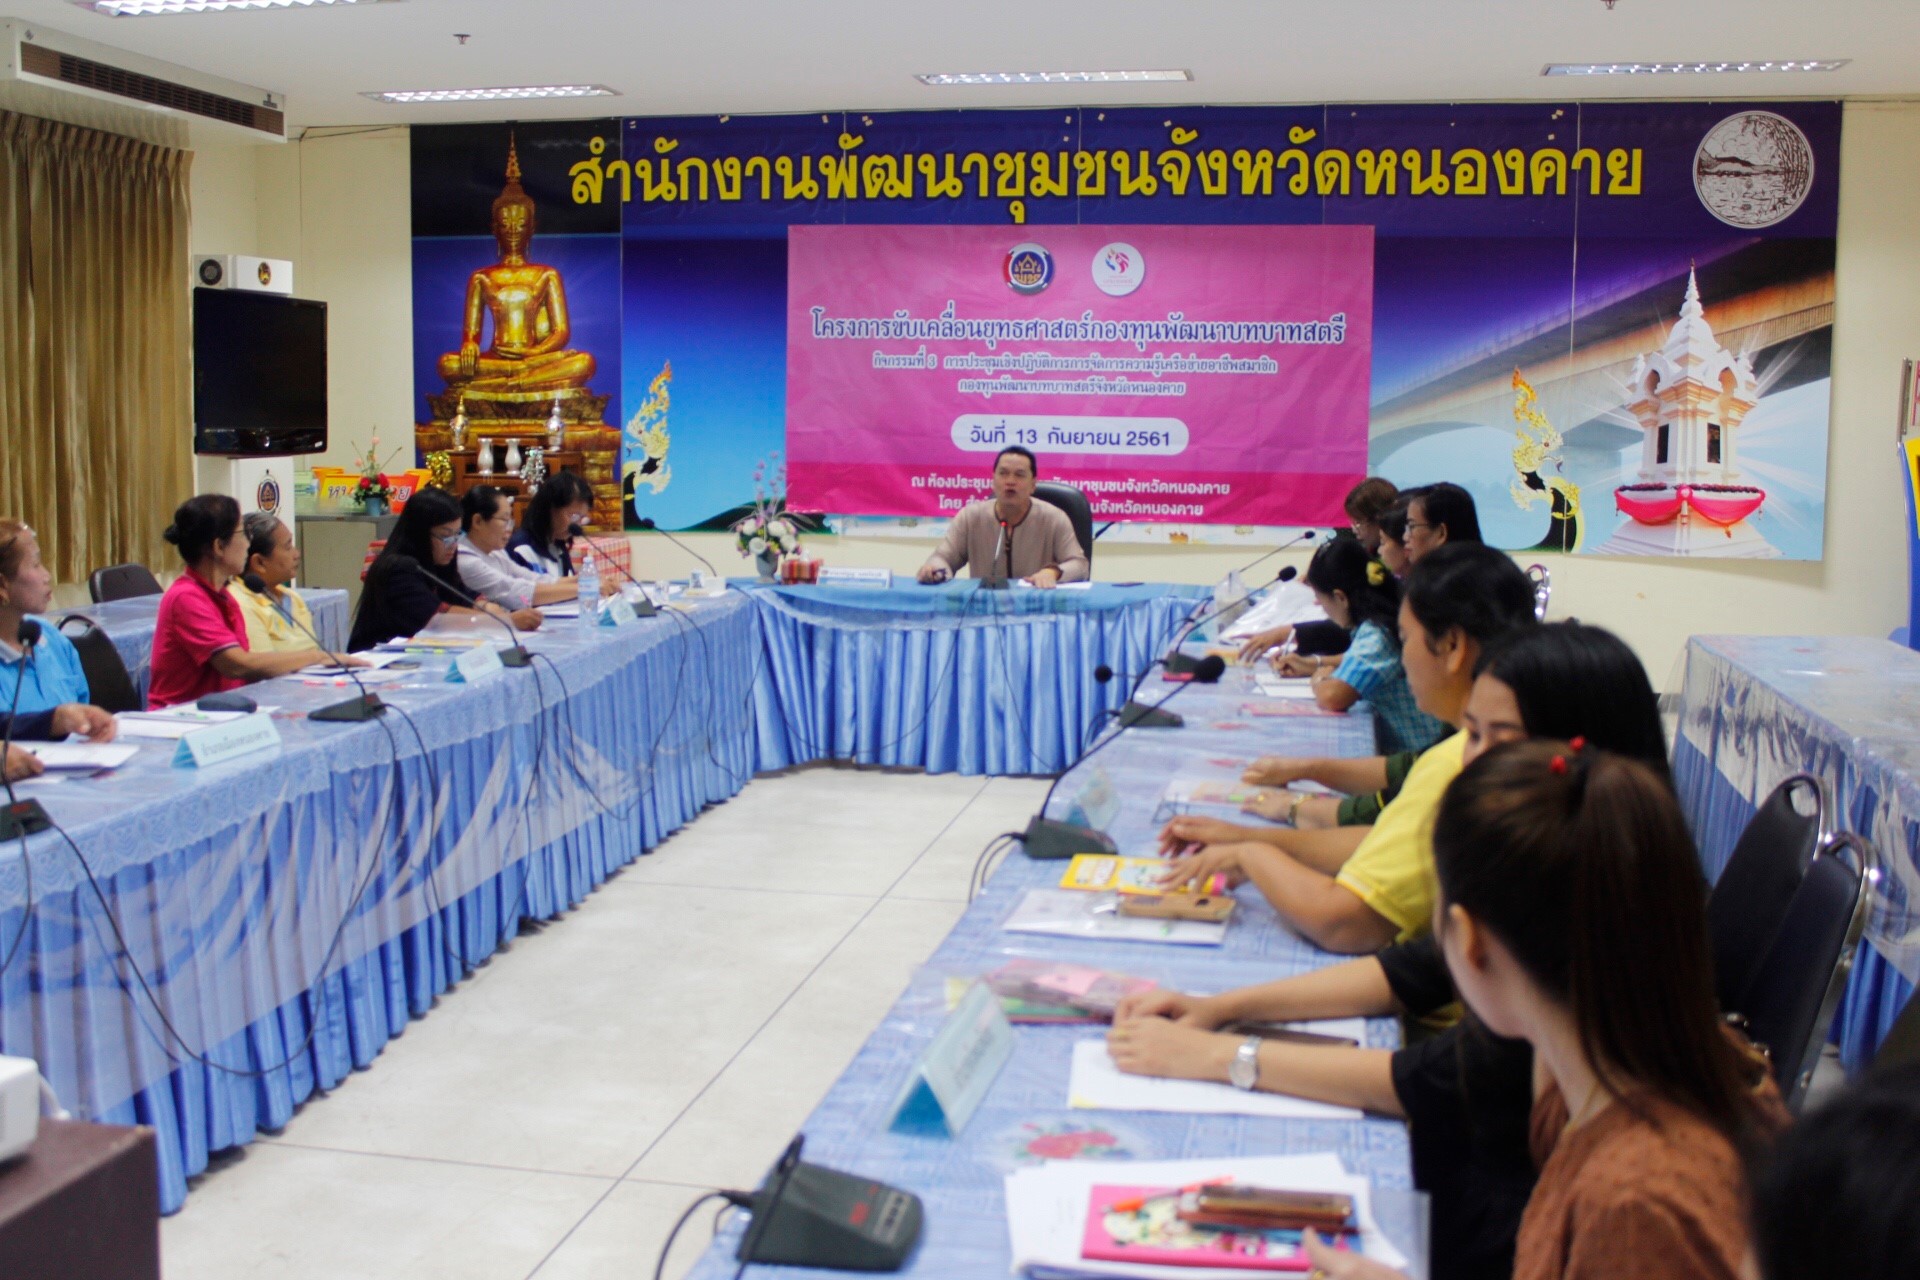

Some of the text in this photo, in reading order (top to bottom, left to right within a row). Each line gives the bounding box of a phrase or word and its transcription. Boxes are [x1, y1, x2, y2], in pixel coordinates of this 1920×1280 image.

[568, 127, 1643, 224] สำนักงานพัฒนาชุมชนจังหวัดหนองคาย
[811, 301, 1345, 350] โครงการขับเคลื่อนยุทธศาสตร์กองทุนพัฒนาบทบาทสตรี
[928, 354, 937, 368] 3
[970, 419, 1170, 447] วันที่ 13 กันยายน 2561
[939, 494, 963, 510] โดย
